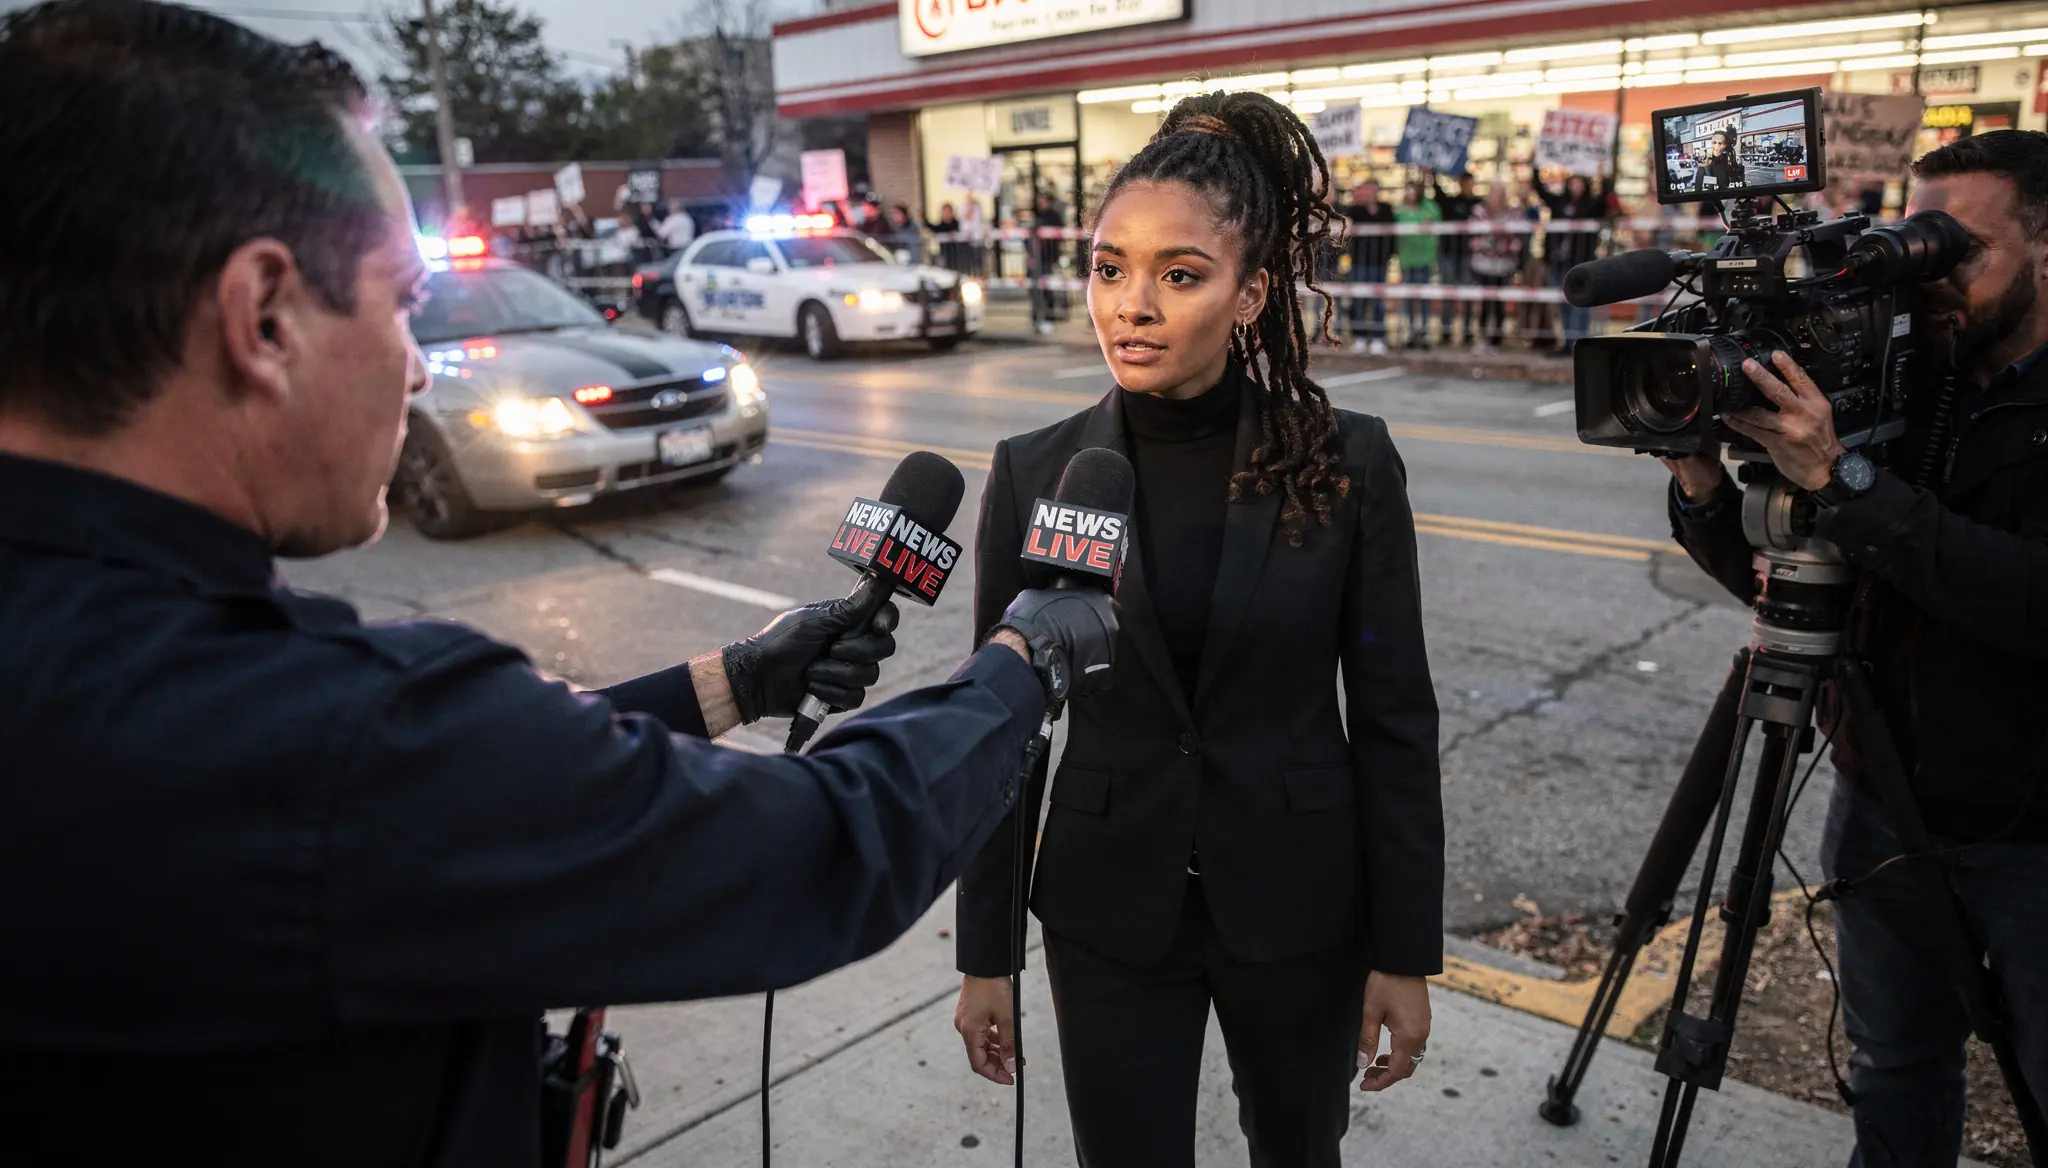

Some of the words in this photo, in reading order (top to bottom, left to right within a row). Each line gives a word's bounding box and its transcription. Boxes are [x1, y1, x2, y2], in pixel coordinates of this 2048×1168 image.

[846, 502, 894, 532] NEWS
[1034, 504, 1122, 540] NEWS
[832, 525, 880, 560] LIVE
[890, 513, 957, 570] NEWS
[1027, 528, 1114, 570] LIVE
[877, 538, 944, 597] LIVE
